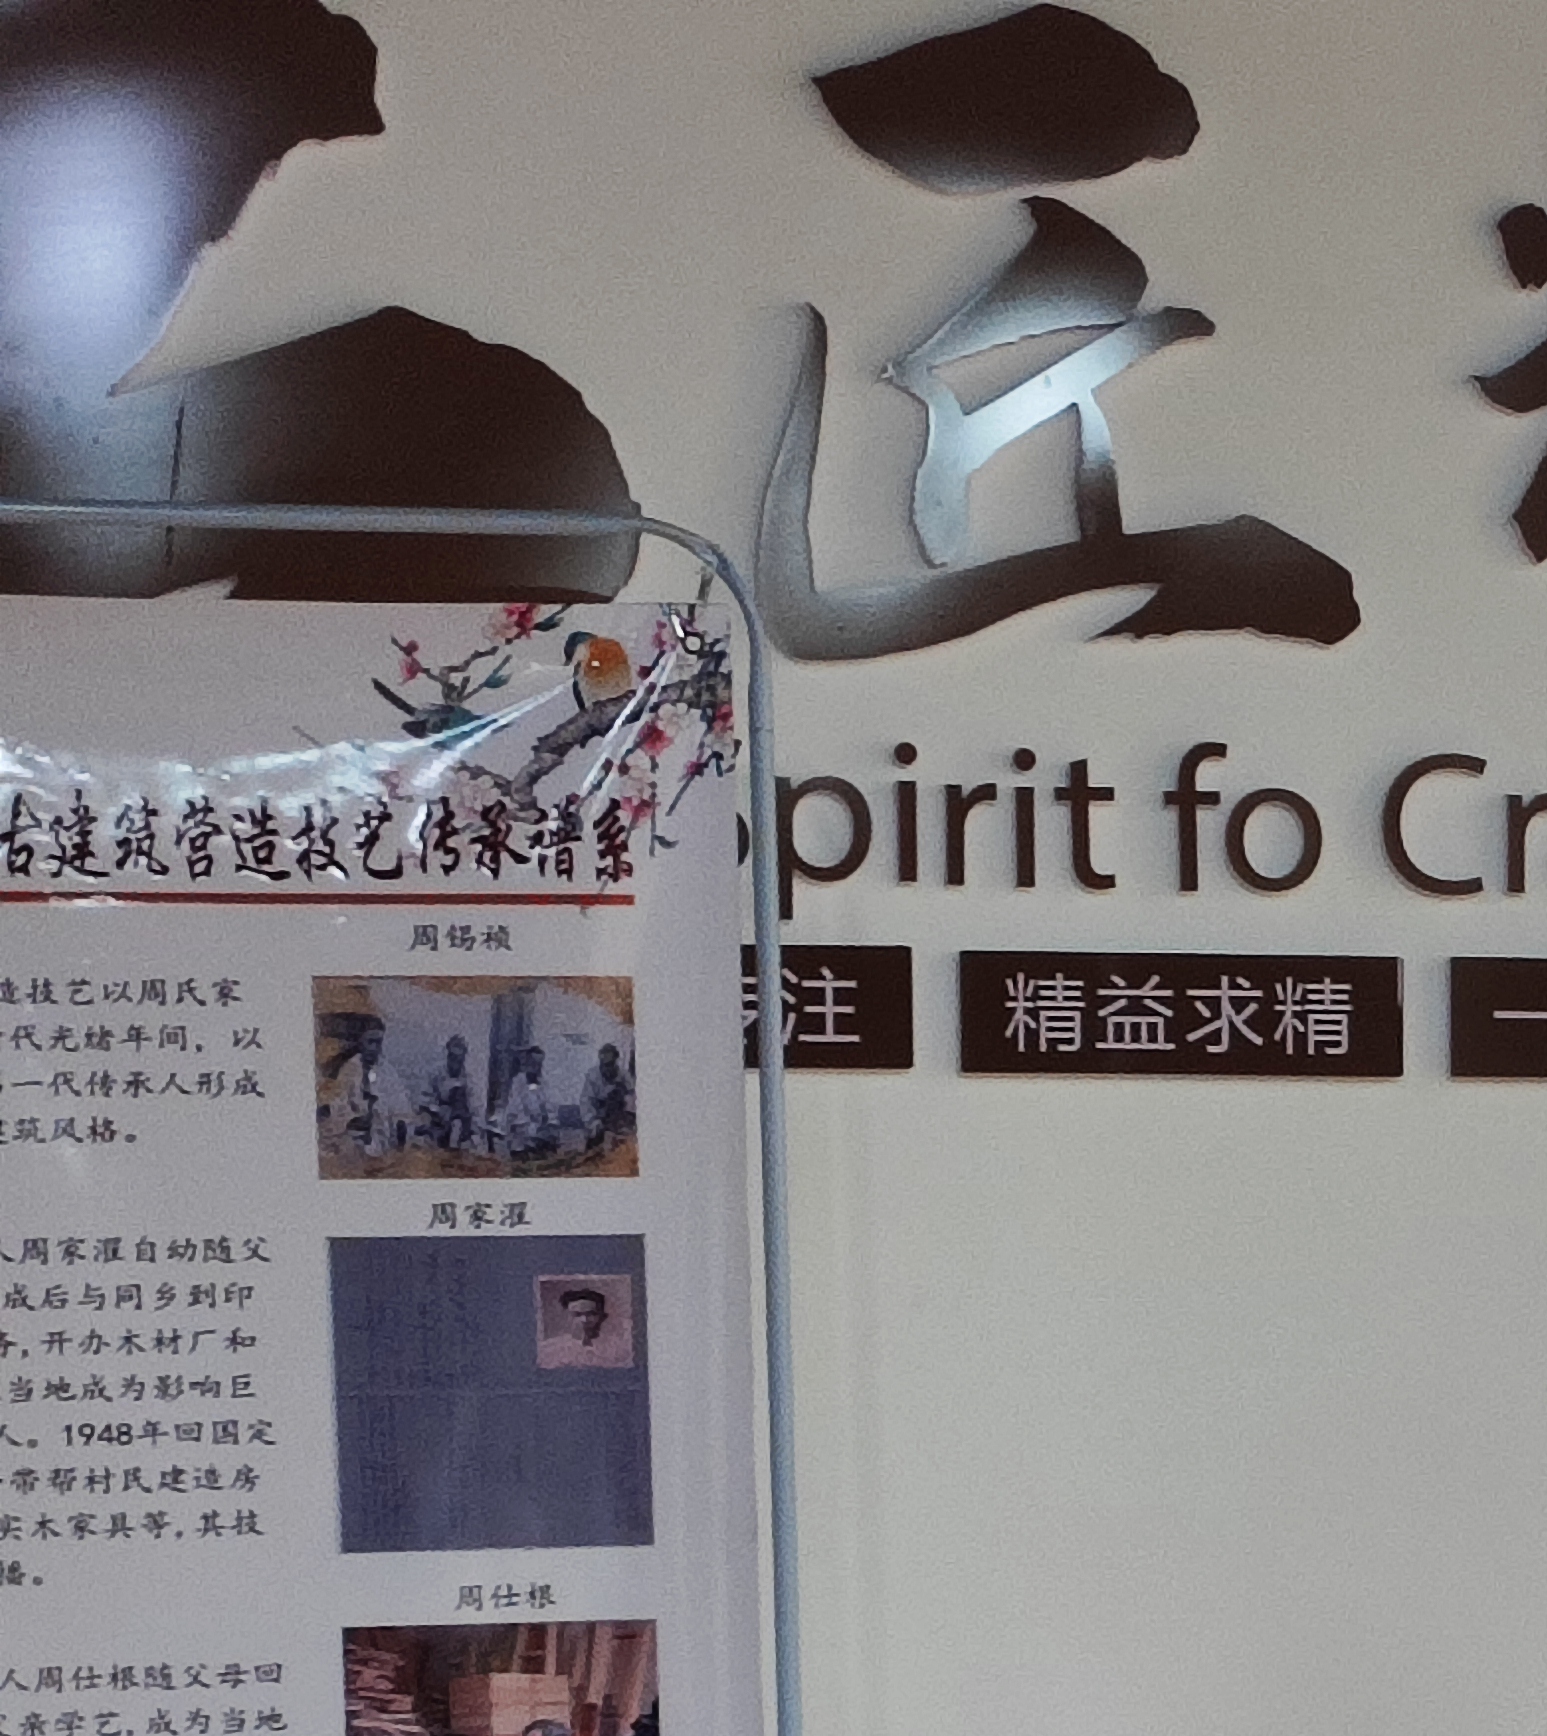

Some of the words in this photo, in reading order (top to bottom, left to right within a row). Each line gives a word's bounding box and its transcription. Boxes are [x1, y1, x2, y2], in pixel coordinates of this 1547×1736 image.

[734, 740, 1116, 921] pirit
[1163, 741, 1323, 893] fo
[1004, 970, 1354, 1056] 精益求精
[0, 1069, 266, 1098] 一代传承人形成
